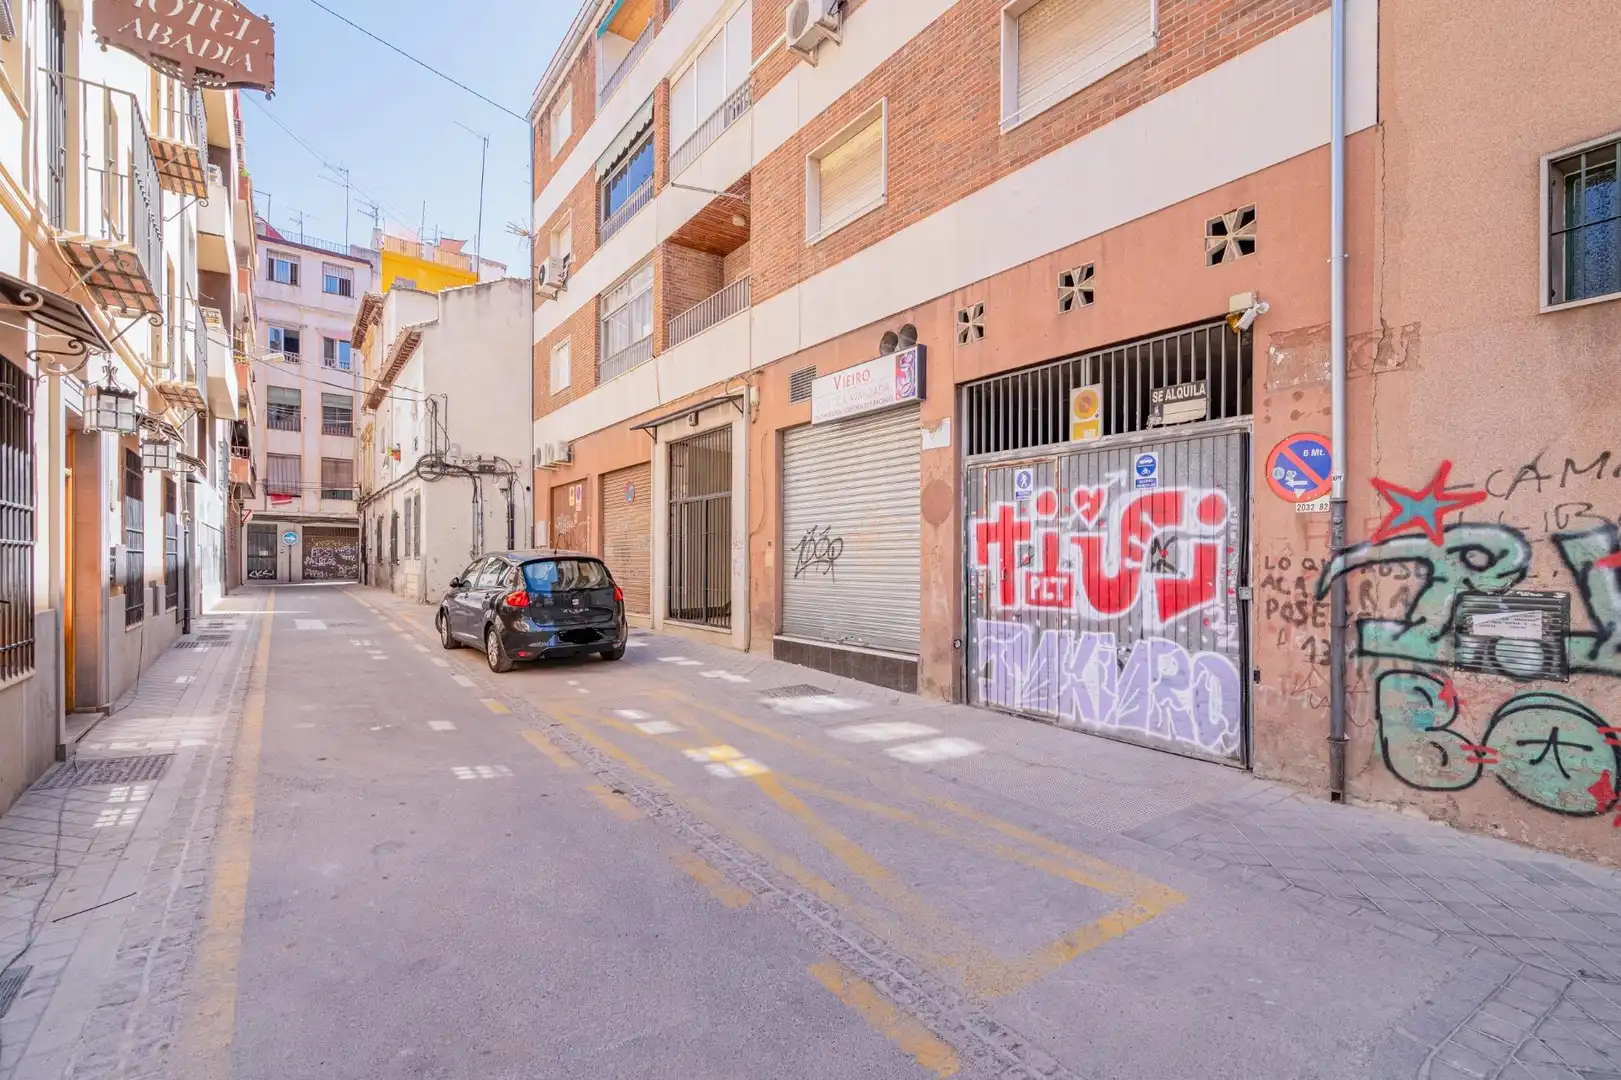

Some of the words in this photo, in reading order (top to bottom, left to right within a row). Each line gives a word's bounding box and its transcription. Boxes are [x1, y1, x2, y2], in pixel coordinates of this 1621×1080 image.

[132, 0, 260, 45] OTEL
[117, 17, 253, 73] ABADIA
[833, 369, 871, 390] VIEIRO
[1152, 389, 1164, 403] SE
[1164, 383, 1207, 401] ALQUILA
[1303, 449, 1309, 457] 6
[1296, 503, 1315, 511] 2032
